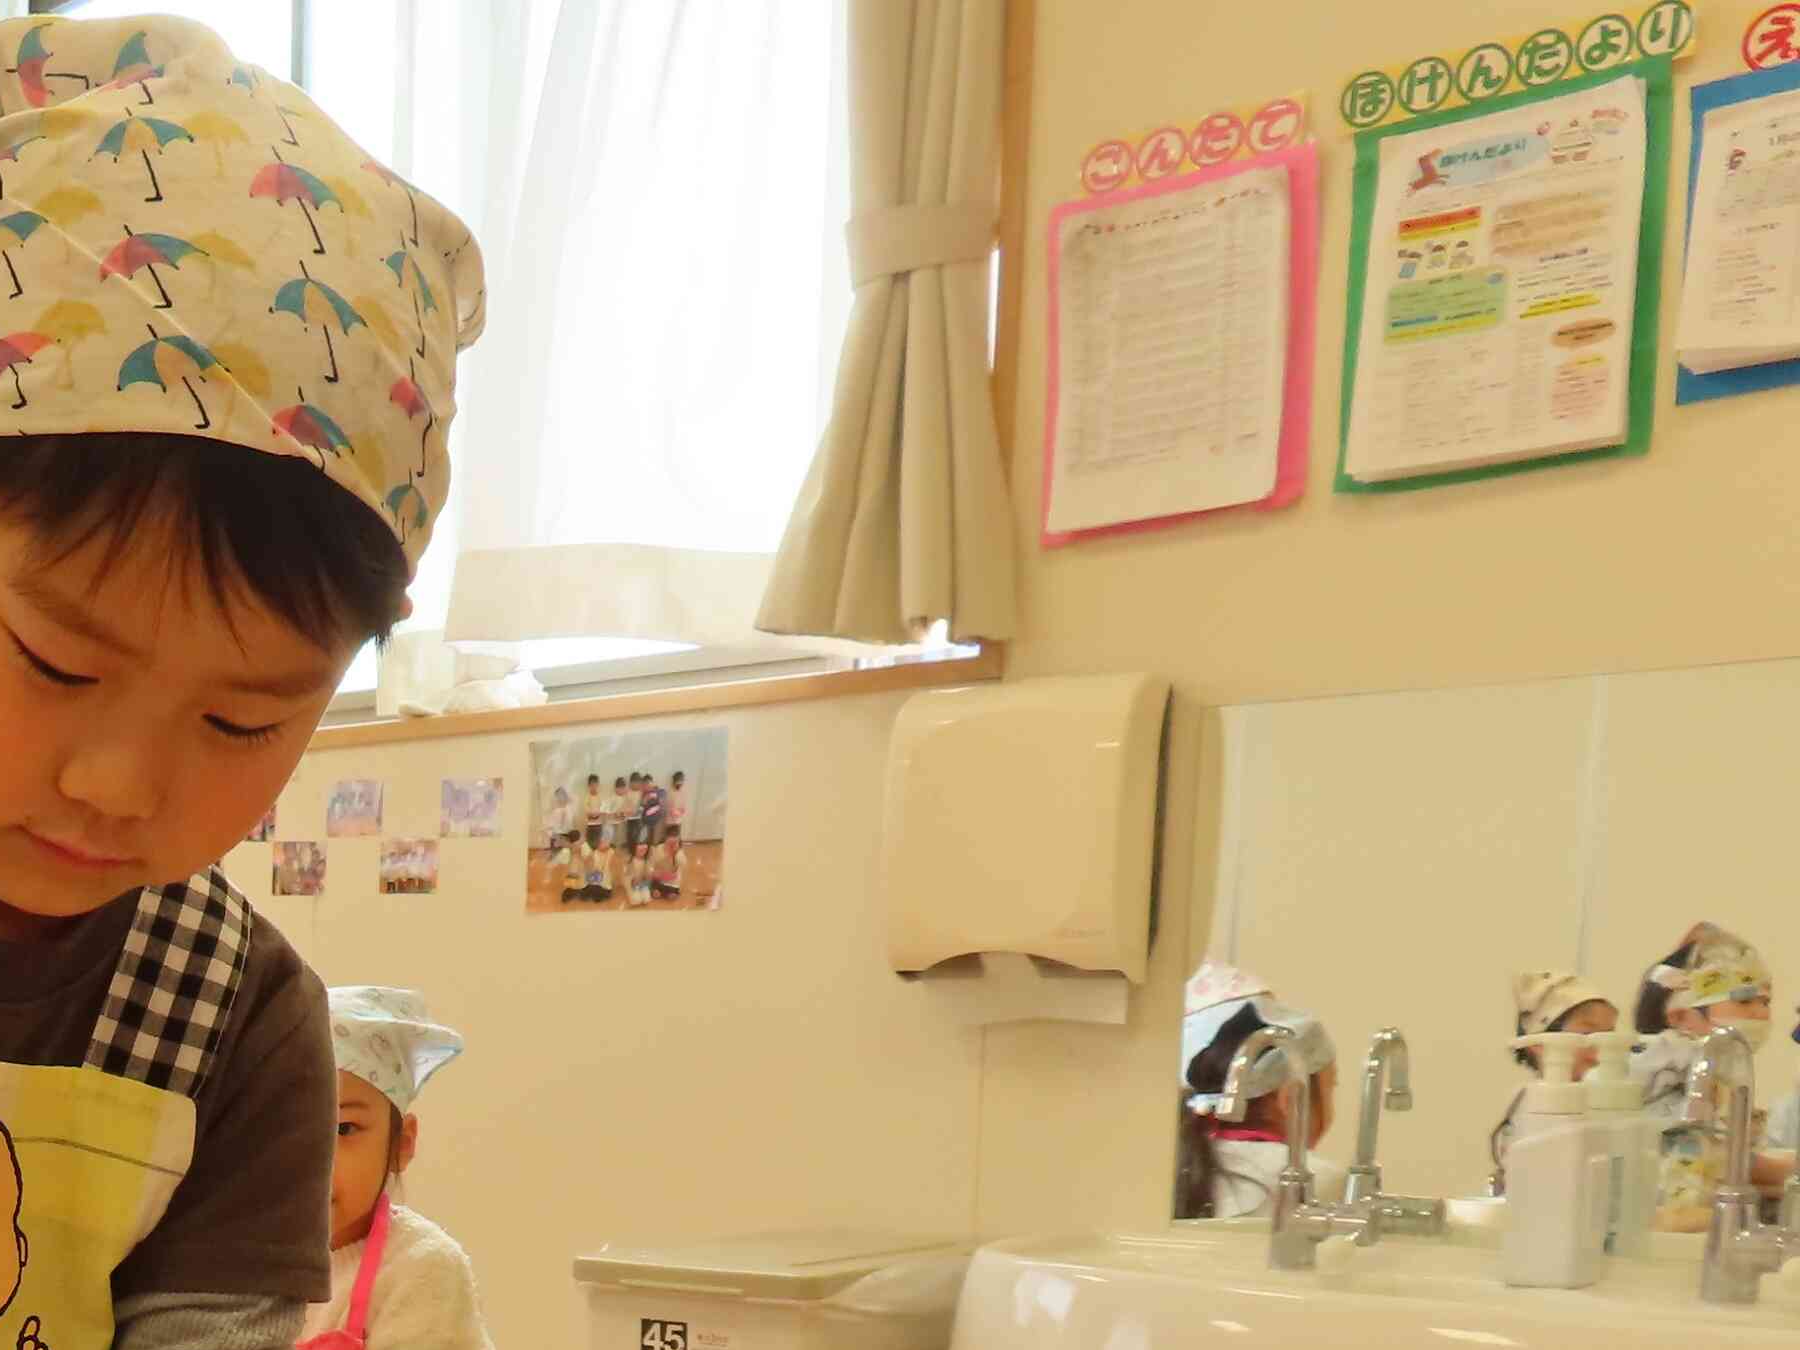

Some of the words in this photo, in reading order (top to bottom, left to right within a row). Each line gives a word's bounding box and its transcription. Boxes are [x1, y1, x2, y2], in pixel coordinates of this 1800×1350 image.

[1345, 3, 1688, 122] ほけんだより
[1085, 102, 1301, 186] こんだて
